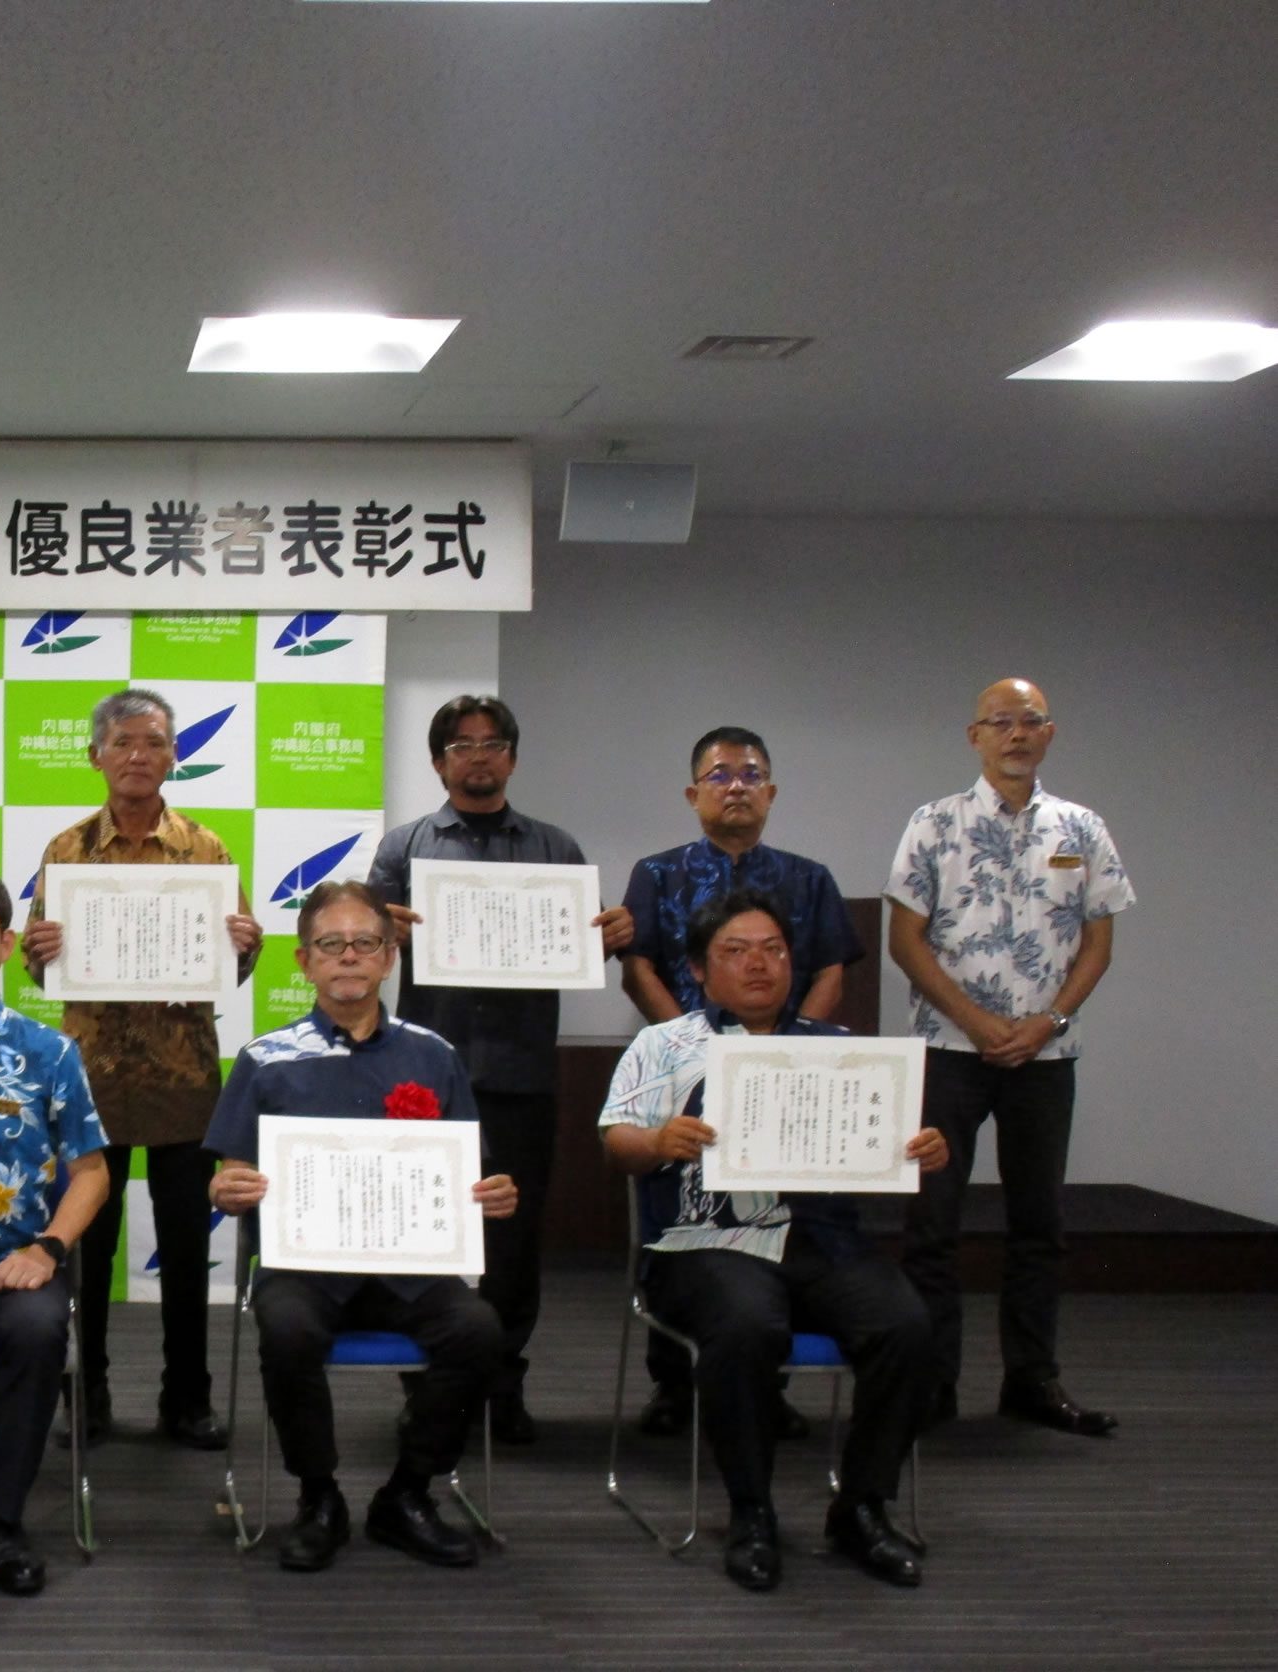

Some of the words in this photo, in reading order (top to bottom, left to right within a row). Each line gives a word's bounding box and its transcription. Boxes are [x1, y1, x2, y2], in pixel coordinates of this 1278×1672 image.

[293, 721, 341, 737] 内閣府
[270, 738, 365, 754] 沖縄総合事務局
